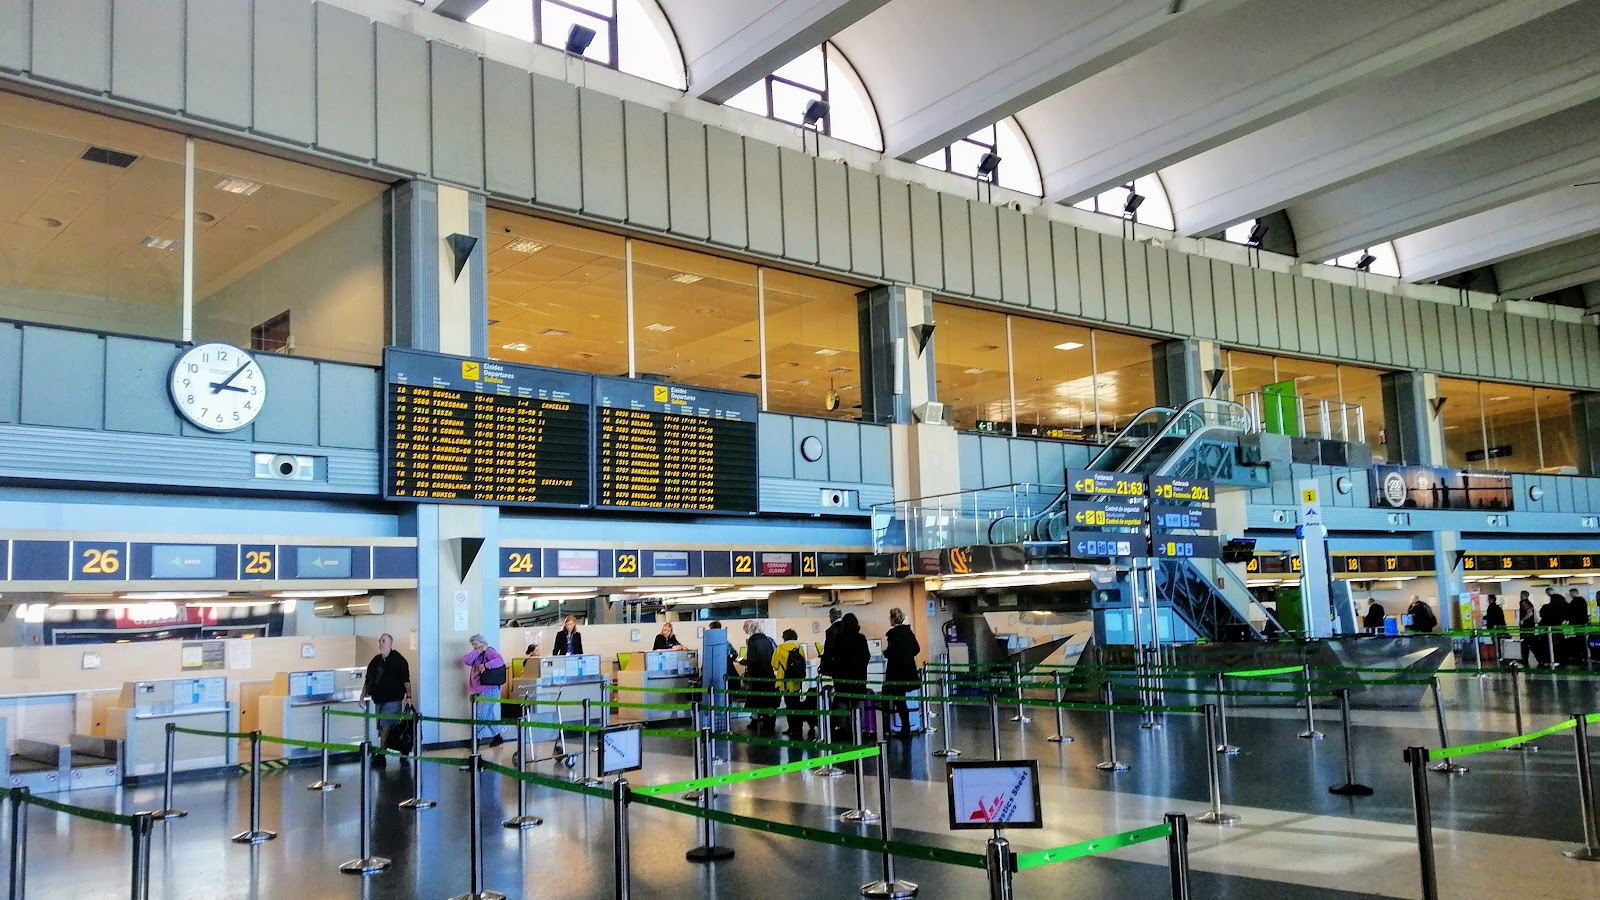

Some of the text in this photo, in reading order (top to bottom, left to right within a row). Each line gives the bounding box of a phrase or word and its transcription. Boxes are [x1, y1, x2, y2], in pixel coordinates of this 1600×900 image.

[202, 352, 209, 363] 11
[217, 351, 228, 361] 12
[187, 363, 199, 373] 10
[246, 369, 254, 379] 2
[483, 369, 515, 380] Departures
[183, 378, 191, 388] 9
[250, 385, 257, 396] 3
[433, 391, 460, 399] SEVILLA
[187, 394, 194, 405] 8
[671, 393, 696, 402] Departures
[243, 400, 252, 410] 4
[433, 400, 468, 409] TIMISOARA
[201, 407, 208, 418] 7
[233, 411, 240, 421] 5
[215, 413, 224, 424] 6
[1105, 505, 1119, 513] Control
[82, 549, 119, 573] 26
[245, 551, 272, 574] 25
[508, 553, 534, 573] 24
[618, 554, 637, 573] 23
[735, 555, 752, 573] 22
[803, 556, 816, 573] 21
[1347, 558, 1358, 571] 18
[1387, 557, 1396, 570] 17
[1464, 557, 1475, 569] 16
[1502, 557, 1513, 569] 15
[1549, 557, 1559, 568] 14
[1582, 556, 1591, 567] 13
[1011, 770, 1028, 796] Sheet
